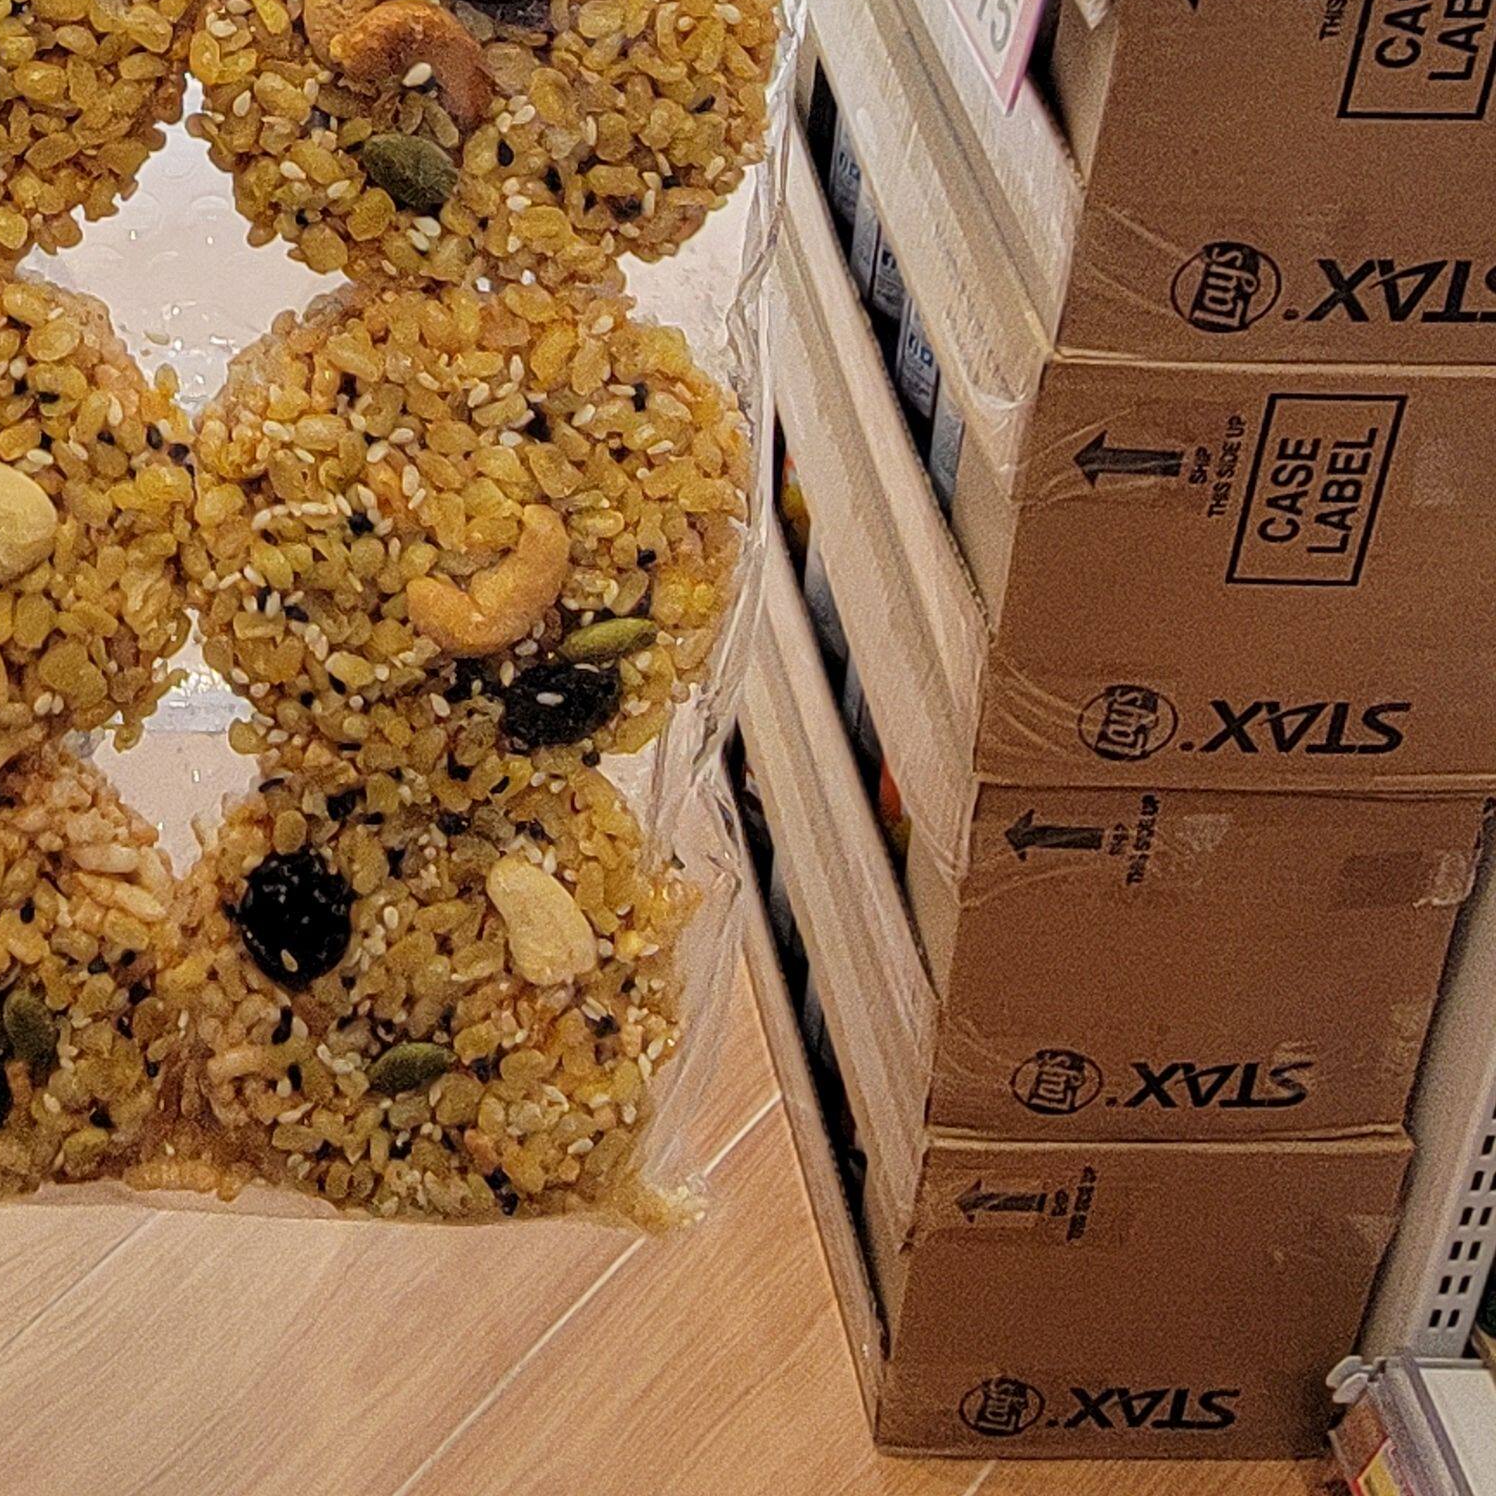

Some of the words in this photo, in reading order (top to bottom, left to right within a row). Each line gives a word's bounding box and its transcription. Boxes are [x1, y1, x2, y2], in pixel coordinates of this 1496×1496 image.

[1257, 437, 1322, 543] CASE
[1306, 427, 1379, 554] LABEL
[1199, 699, 1412, 754] STAX
[1124, 1061, 1314, 1110] STAX
[1064, 1386, 1241, 1431] STAX
